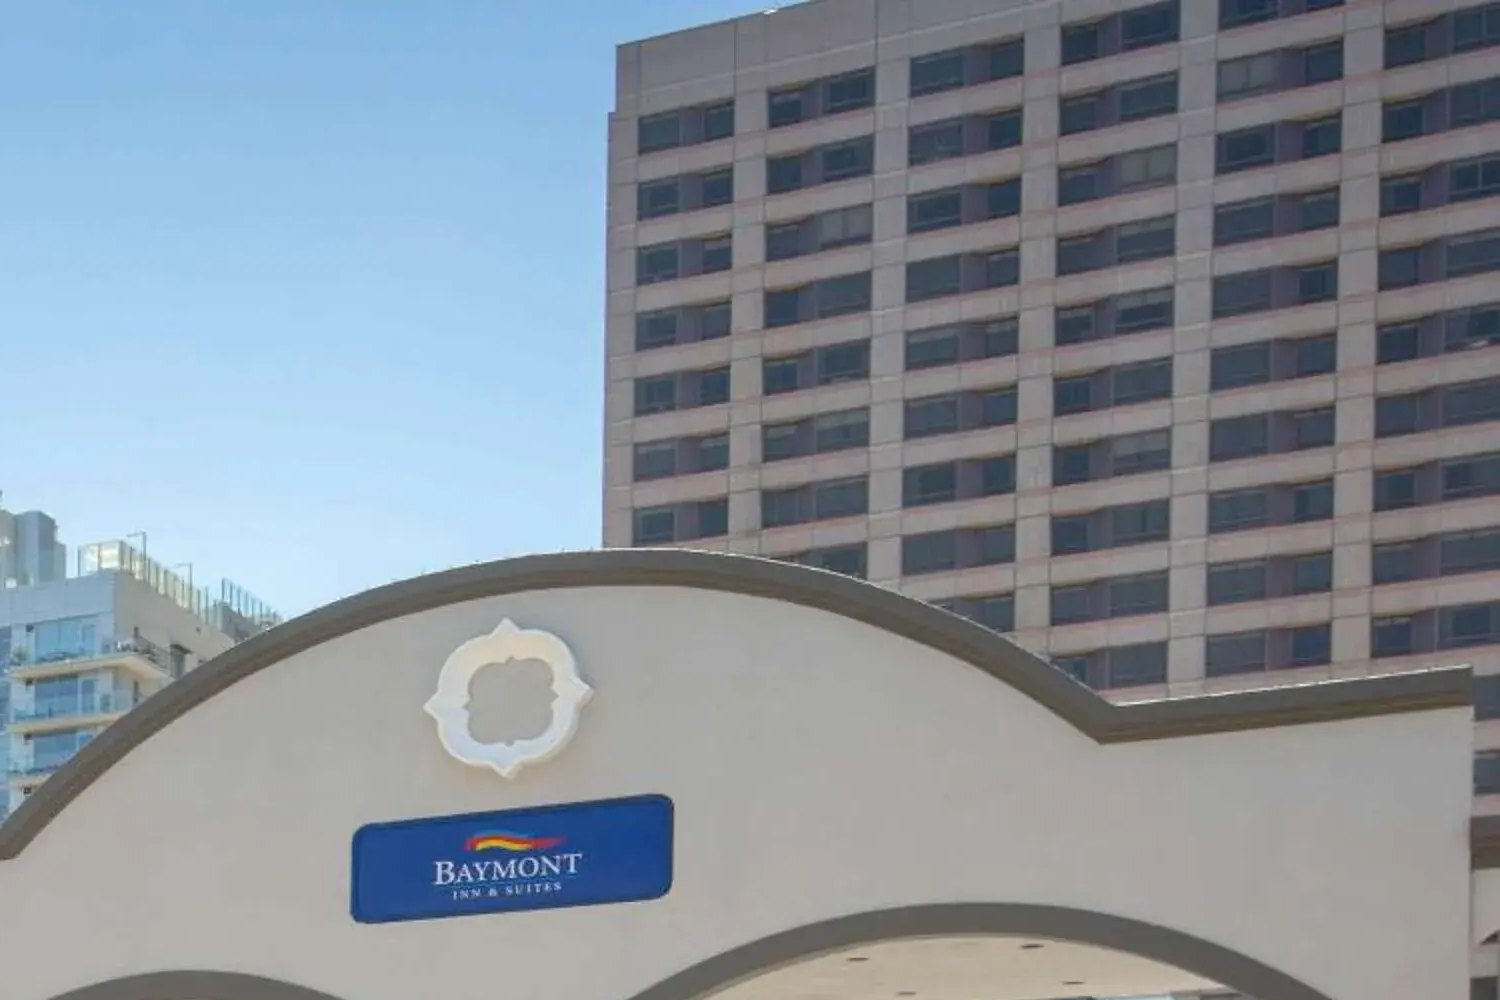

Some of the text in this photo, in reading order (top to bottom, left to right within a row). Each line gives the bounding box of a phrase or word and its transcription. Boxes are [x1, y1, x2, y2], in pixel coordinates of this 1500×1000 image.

[433, 853, 583, 886] BAYMONT
[453, 881, 562, 900] INN & SUITES
